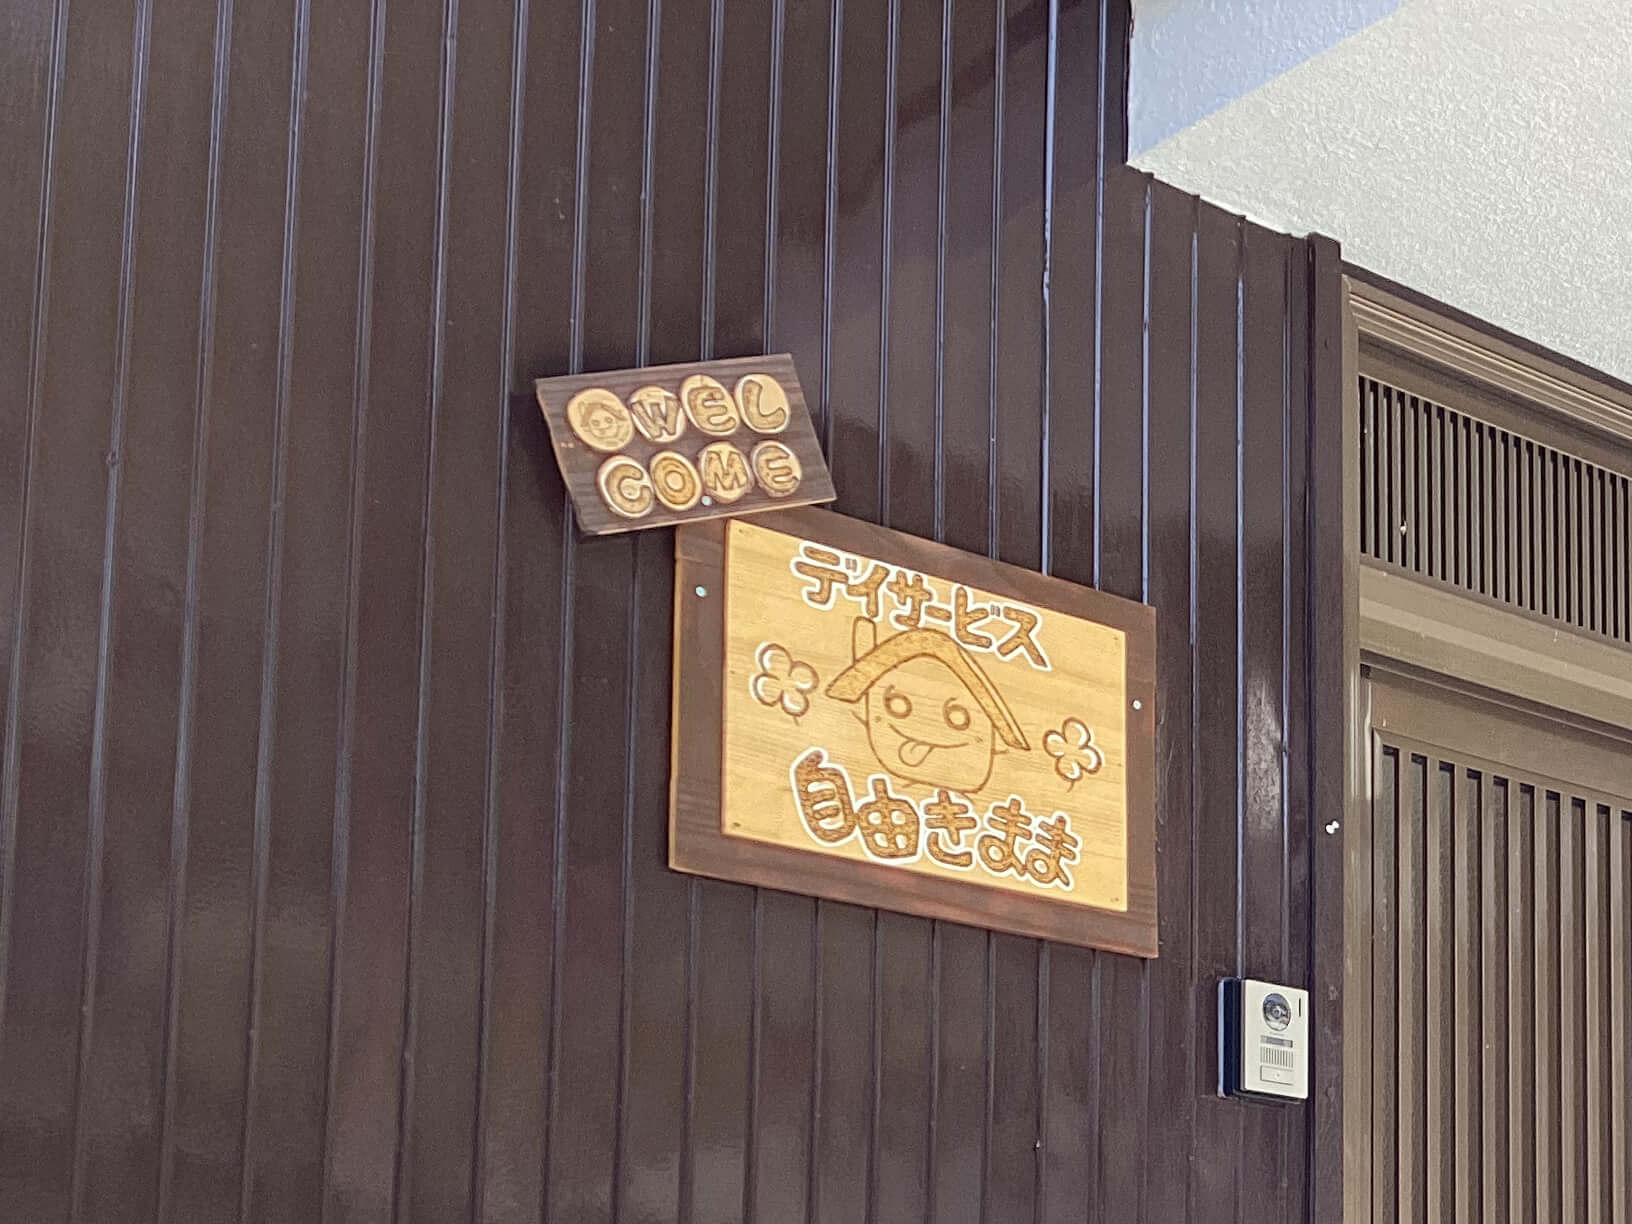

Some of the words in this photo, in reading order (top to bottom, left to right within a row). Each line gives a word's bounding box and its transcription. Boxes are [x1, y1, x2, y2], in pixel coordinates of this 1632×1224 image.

[631, 378, 787, 440] WEL
[605, 447, 800, 514] COME
[791, 543, 1050, 670] デイサービス
[793, 749, 1080, 888] 自由きまま
